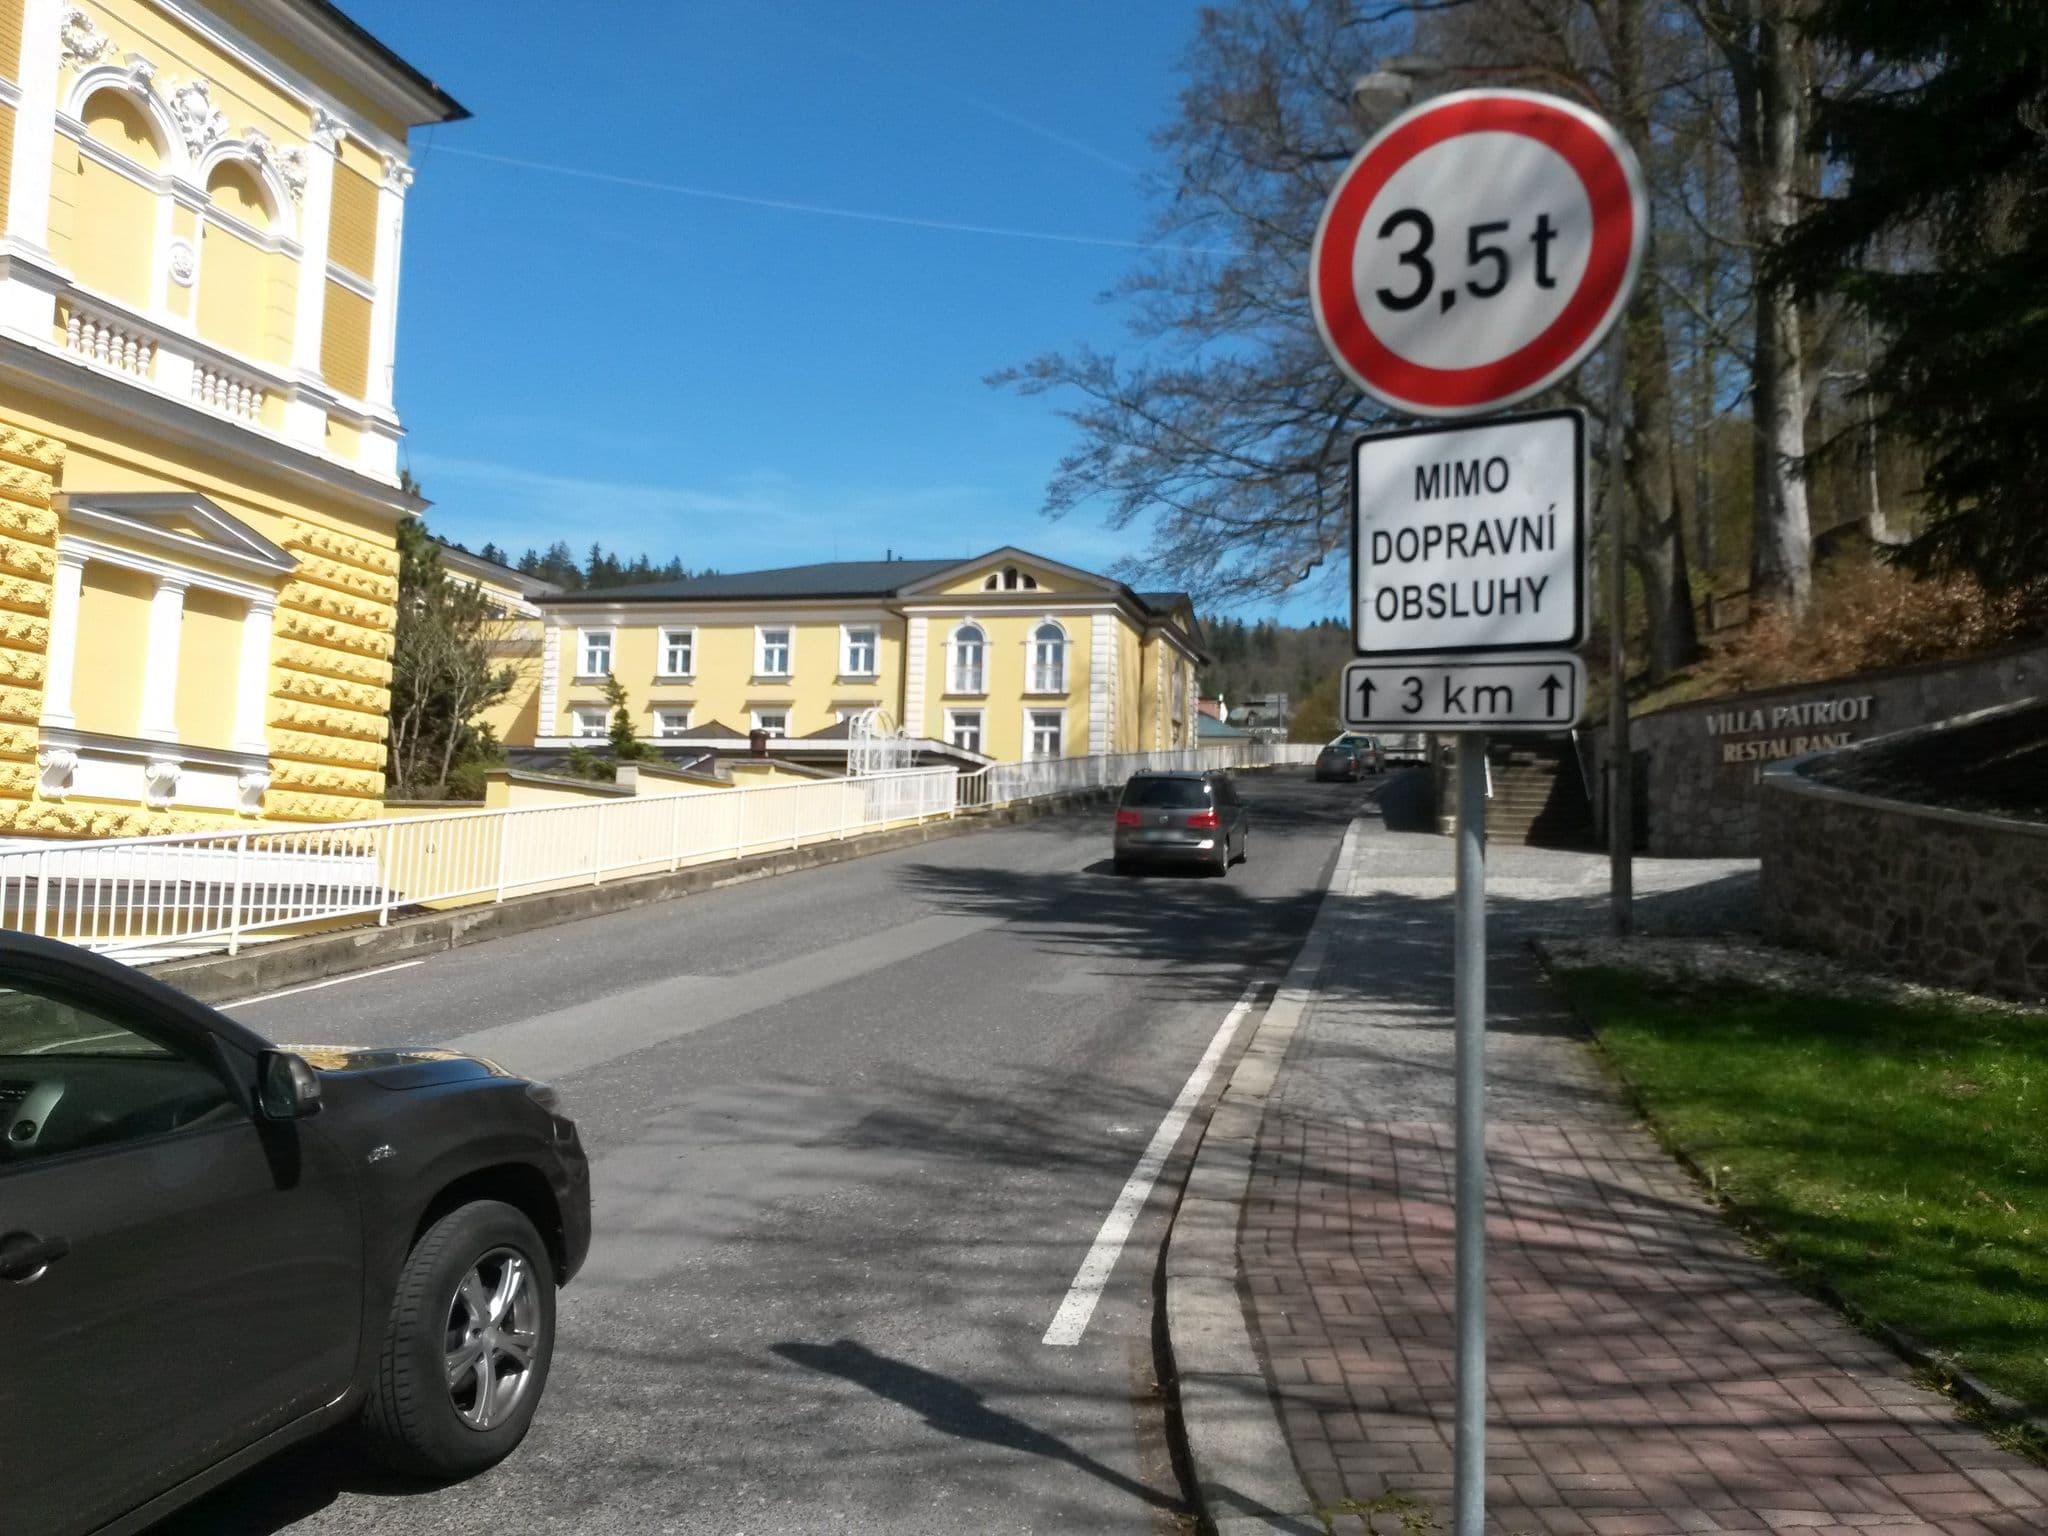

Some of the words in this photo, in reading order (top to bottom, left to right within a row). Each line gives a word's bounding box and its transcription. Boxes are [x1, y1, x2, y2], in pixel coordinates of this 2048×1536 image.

[1415, 456, 1510, 501] MIMO
[1373, 504, 1557, 566] DOPRAVNÍ
[1375, 575, 1550, 623] OBSLUHY
[1401, 676, 1423, 714] 3
[1443, 675, 1512, 714] km
[1706, 709, 1765, 736] VILLA
[1772, 696, 1872, 728] PATRIOT
[1723, 733, 1851, 763] RESTAURANT
